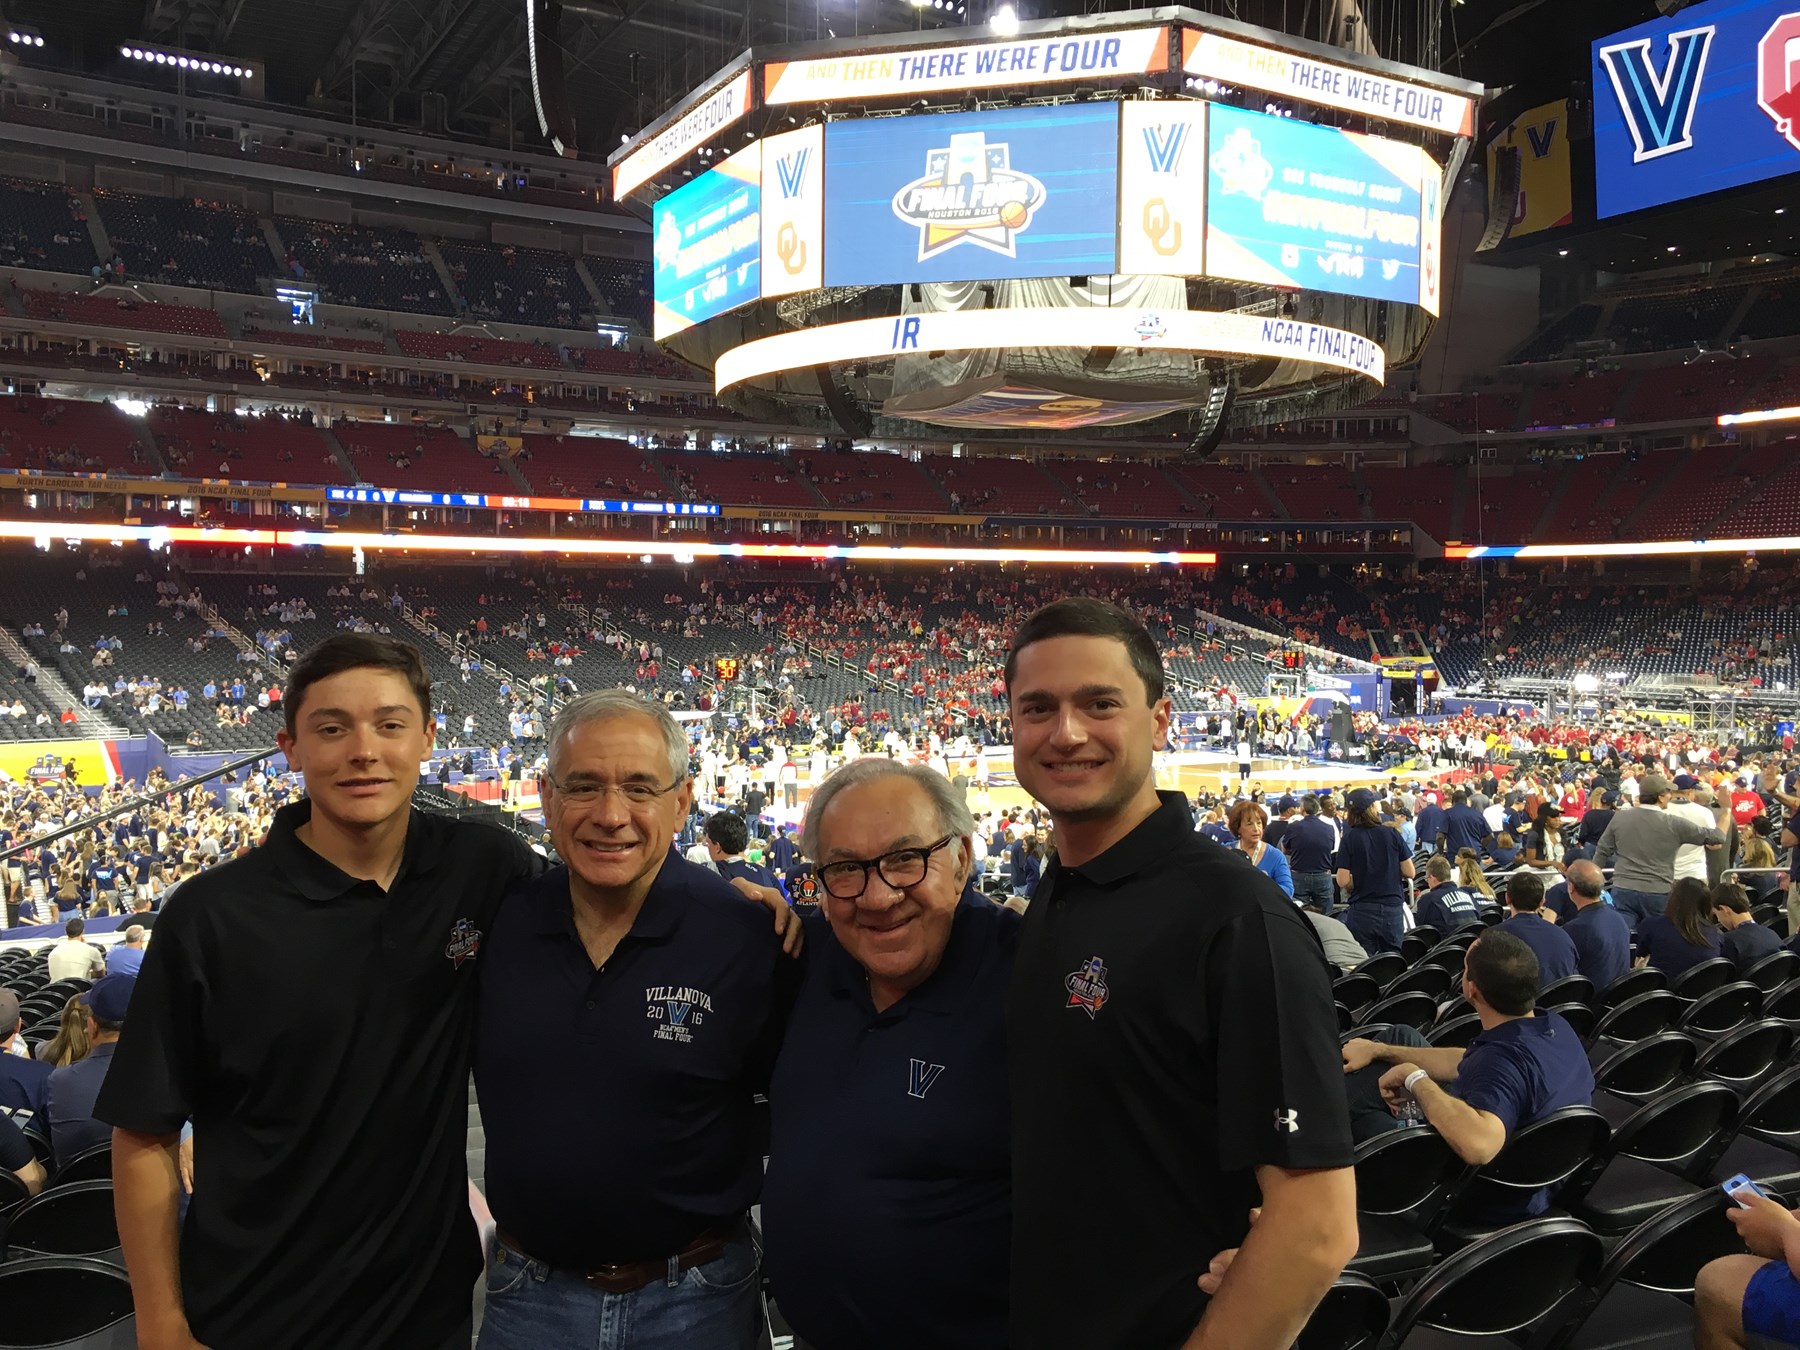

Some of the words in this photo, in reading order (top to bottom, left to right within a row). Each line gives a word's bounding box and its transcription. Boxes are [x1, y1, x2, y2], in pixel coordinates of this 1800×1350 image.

[842, 59, 893, 81] THEN
[899, 52, 966, 81] THERE
[975, 46, 1040, 74] WERE
[1043, 37, 1122, 74] FOUR
[1247, 49, 1287, 78] THEN
[1291, 61, 1341, 94] THERE
[1347, 74, 1390, 106] WERE
[1393, 87, 1444, 123] FOUR
[1600, 25, 1715, 163] V
[680, 110, 703, 145] WERE
[703, 89, 733, 133] FOUR
[1525, 117, 1560, 161] V
[907, 185, 967, 212] FINAL
[927, 209, 972, 219] HOUSTON
[1261, 320, 1303, 347] NCAA
[1308, 327, 1347, 360] FINAL
[1347, 336, 1377, 372] FOUR
[17, 477, 44, 487] NORTH
[45, 478, 84, 488] CAROLINA
[87, 480, 102, 489] TAR
[207, 487, 228, 495] NCAA
[230, 488, 250, 496] FINAL
[252, 488, 272, 497] FOUR
[720, 667, 734, 678] 30
[30, 767, 49, 775] FINAL
[1069, 976, 1090, 993] FINAL
[646, 986, 713, 1012] VILLANOVA
[647, 1005, 664, 1019] 20
[667, 1001, 692, 1025] V
[691, 1011, 703, 1025] 16
[653, 1029, 674, 1041] FINAL
[674, 1032, 692, 1043] FOUR
[908, 1058, 945, 1098] V
